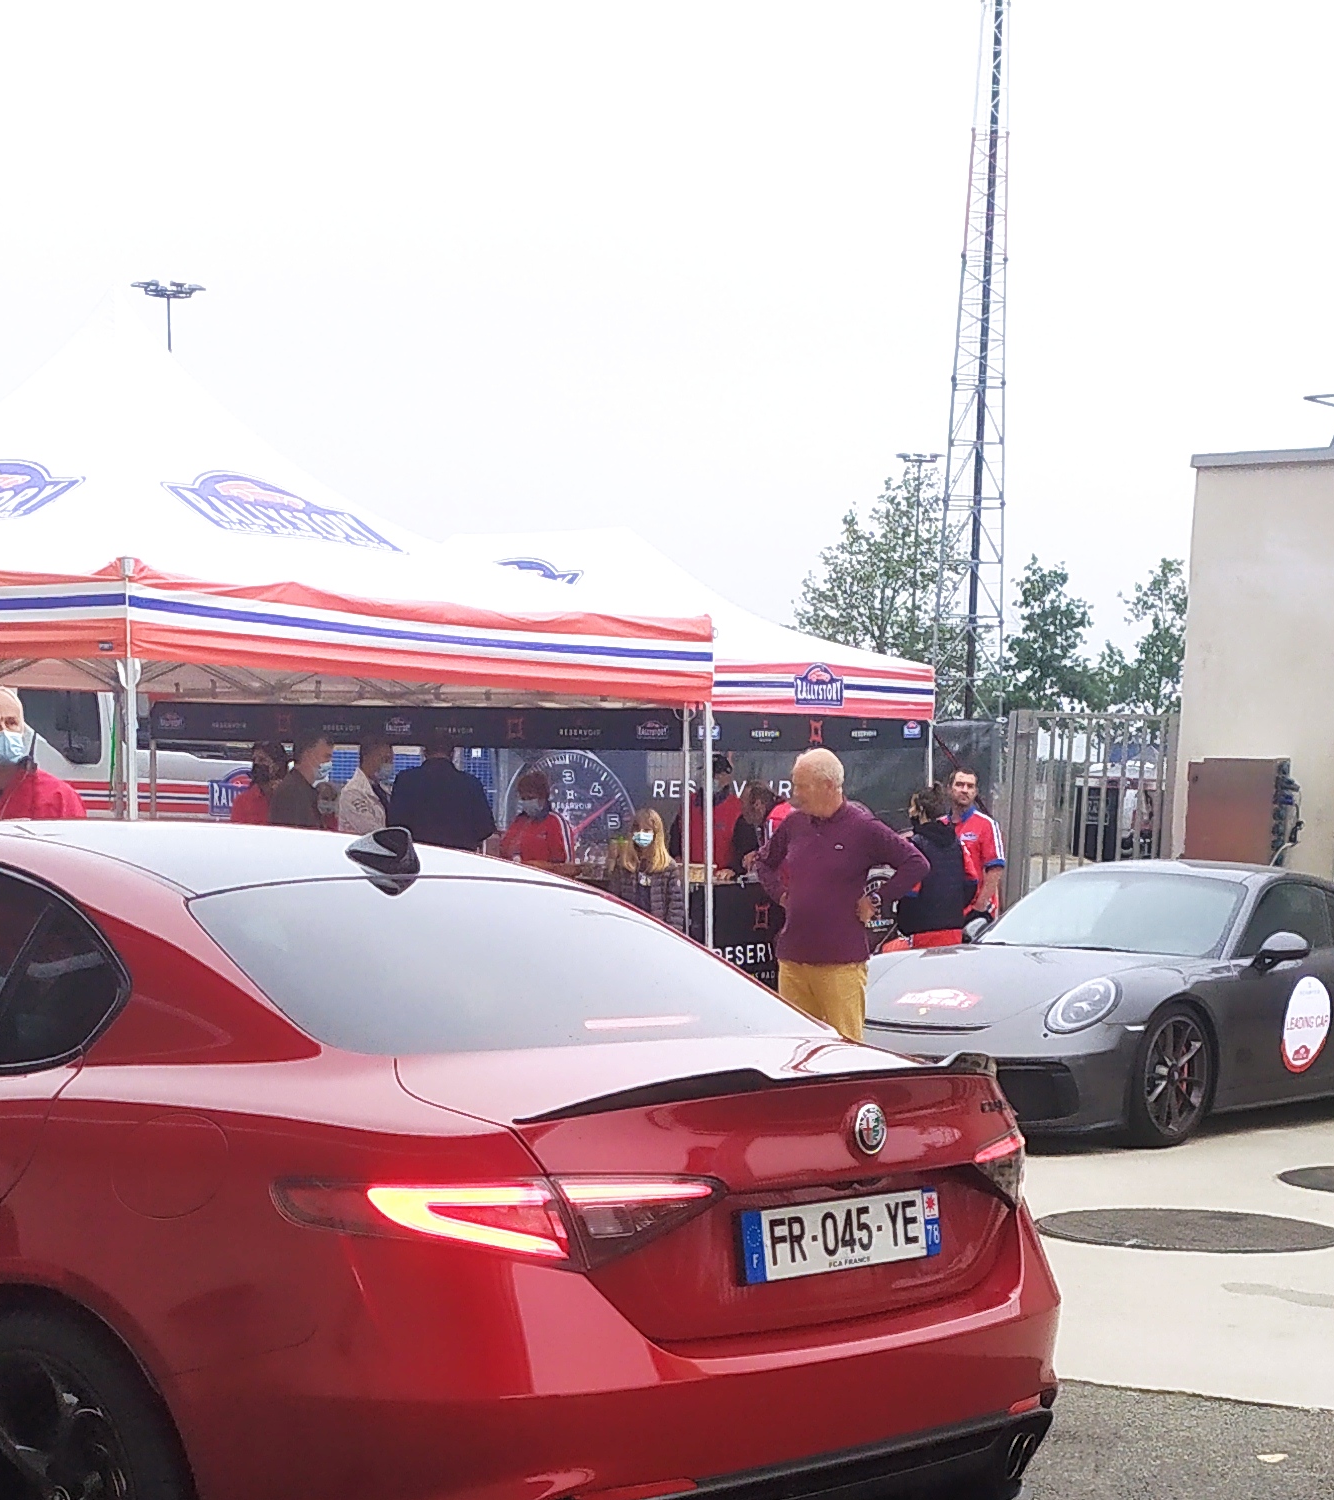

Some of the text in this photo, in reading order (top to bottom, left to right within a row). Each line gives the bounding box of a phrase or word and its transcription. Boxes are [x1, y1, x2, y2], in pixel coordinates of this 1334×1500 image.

[174, 487, 383, 542] RALLYSTORY
[797, 678, 842, 700] RALLYSTORY
[562, 769, 575, 784] 3
[590, 782, 604, 797] 4
[608, 813, 621, 829] 5
[1286, 1016, 1314, 1030] LEADING
[927, 1224, 941, 1245] 78
[752, 1253, 760, 1268] F
[828, 1256, 871, 1268] FCA FRANCE
